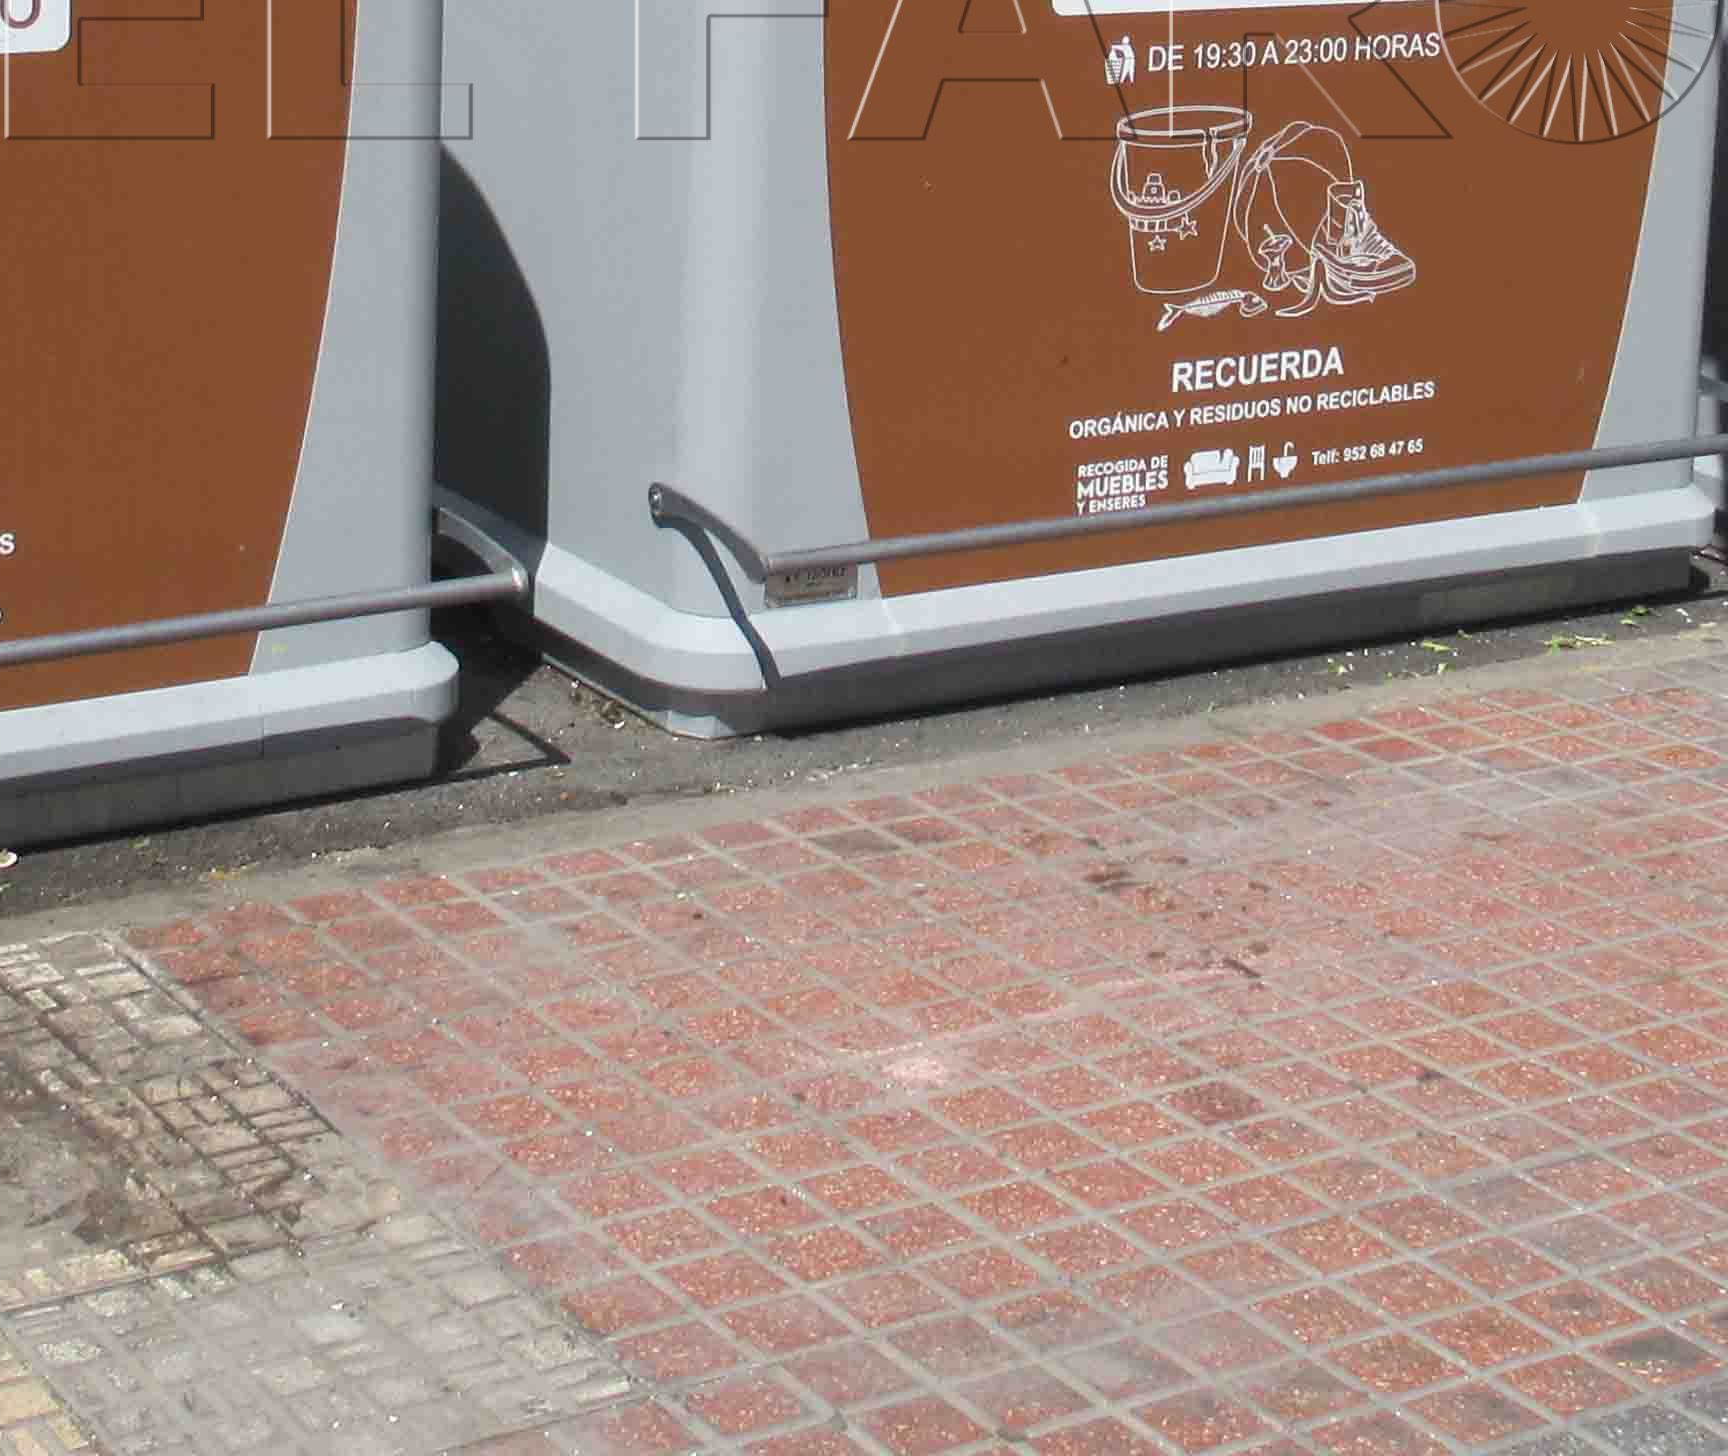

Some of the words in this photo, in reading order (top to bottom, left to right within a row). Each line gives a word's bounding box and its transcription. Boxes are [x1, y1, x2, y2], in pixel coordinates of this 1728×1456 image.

[1148, 44, 1184, 72] DE
[1193, 40, 1256, 68] 19:30
[1261, 40, 1279, 65] A
[1285, 37, 1346, 64] 23:00
[1355, 32, 1441, 61] HORAS
[1172, 346, 1344, 392] RECUERDA
[1069, 411, 1168, 439] ORGÁNICA
[1174, 409, 1186, 428] Y
[1190, 397, 1281, 426] RESIDUOS
[1286, 394, 1312, 414] NO
[1317, 381, 1435, 412] RECICLABLES
[1077, 458, 1147, 477] RECOGIDA
[1151, 455, 1168, 469] DE
[1311, 447, 1339, 466] Telf:
[1343, 444, 1366, 462] 952
[1370, 443, 1386, 459] 68
[1389, 441, 1404, 457] 47
[1408, 438, 1423, 454] 65
[1076, 470, 1169, 500] MUEBLES
[1076, 498, 1086, 515] Y
[1089, 494, 1146, 514] ENSERES
